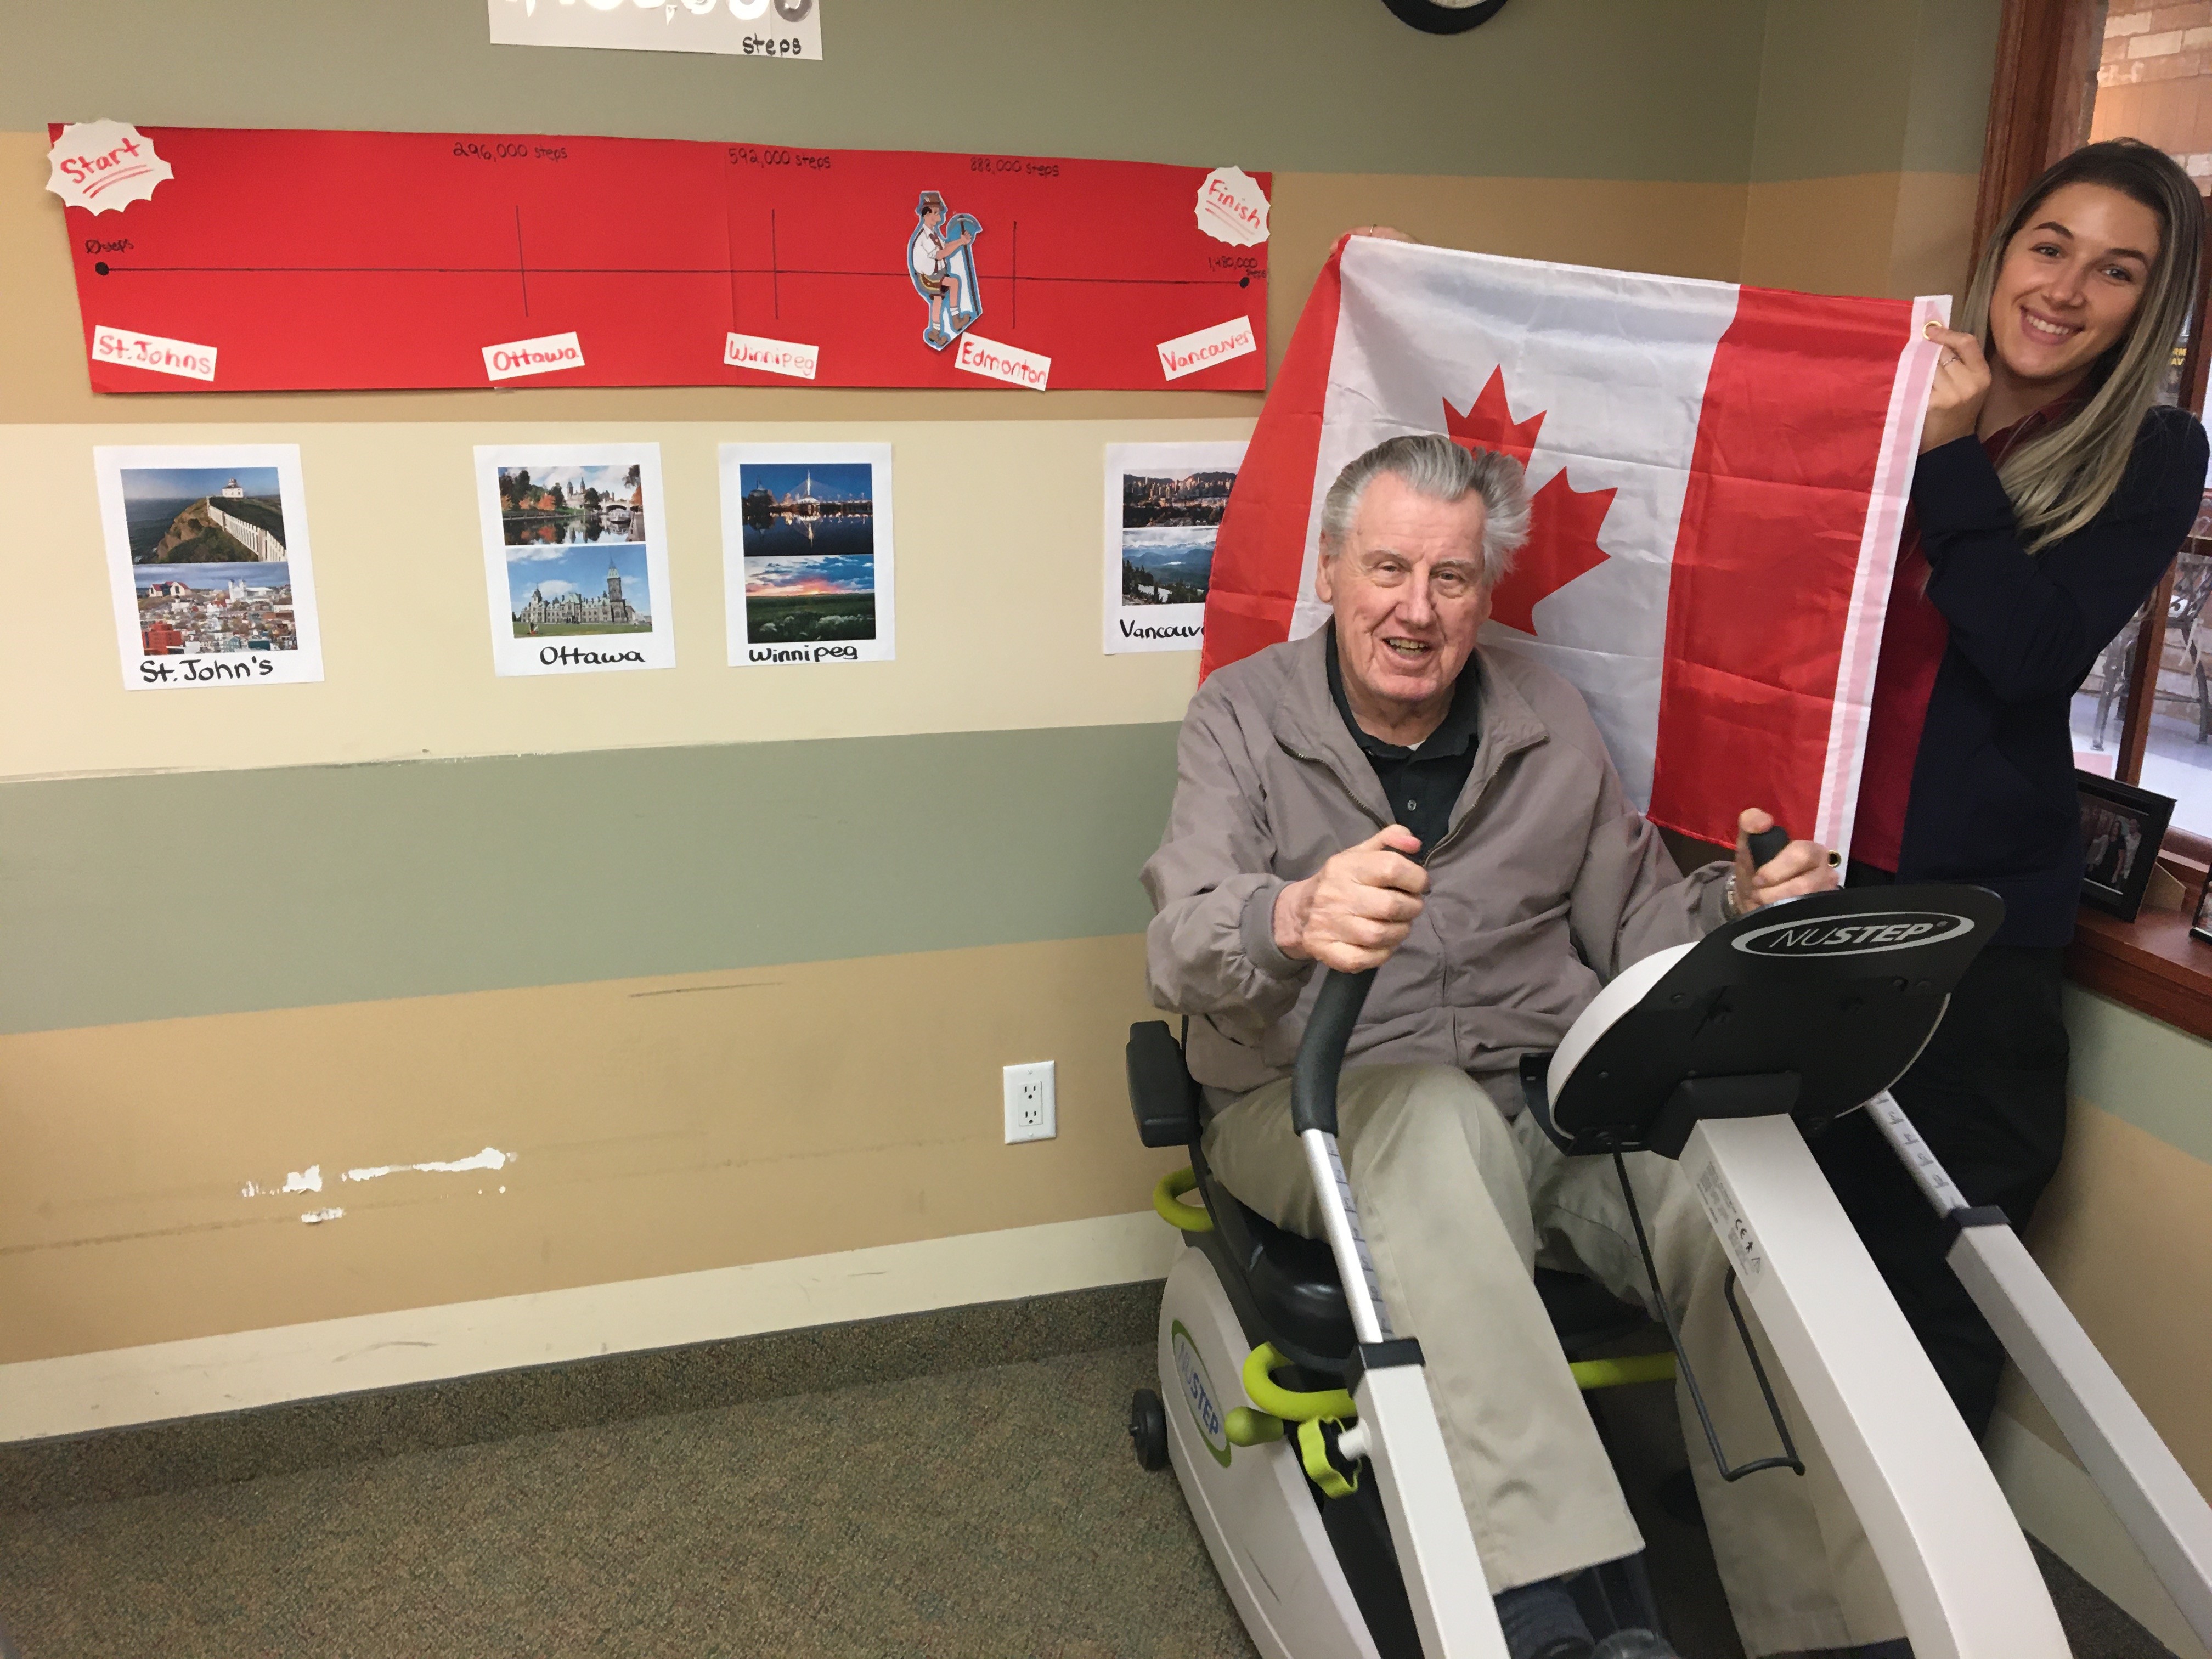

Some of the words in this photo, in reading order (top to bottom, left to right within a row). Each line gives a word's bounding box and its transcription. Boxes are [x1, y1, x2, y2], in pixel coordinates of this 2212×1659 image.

[742, 33, 801, 57] steps
[59, 137, 141, 184] Start
[453, 142, 527, 162] 296,000
[534, 144, 568, 162] steps
[729, 148, 790, 168] 592,000
[796, 152, 831, 171] steps
[1026, 163, 1059, 178] steps
[1207, 179, 1261, 229] Finish
[493, 347, 580, 374] Ottawa
[728, 339, 815, 376] Winnipeg
[961, 341, 1046, 385] Edmonton
[1162, 328, 1251, 373] Vancouver
[1120, 619, 1204, 639] Vancouv
[539, 645, 646, 665] Ottawa
[748, 644, 859, 663] Winnipeg
[1768, 922, 1935, 949] NUSTEP
